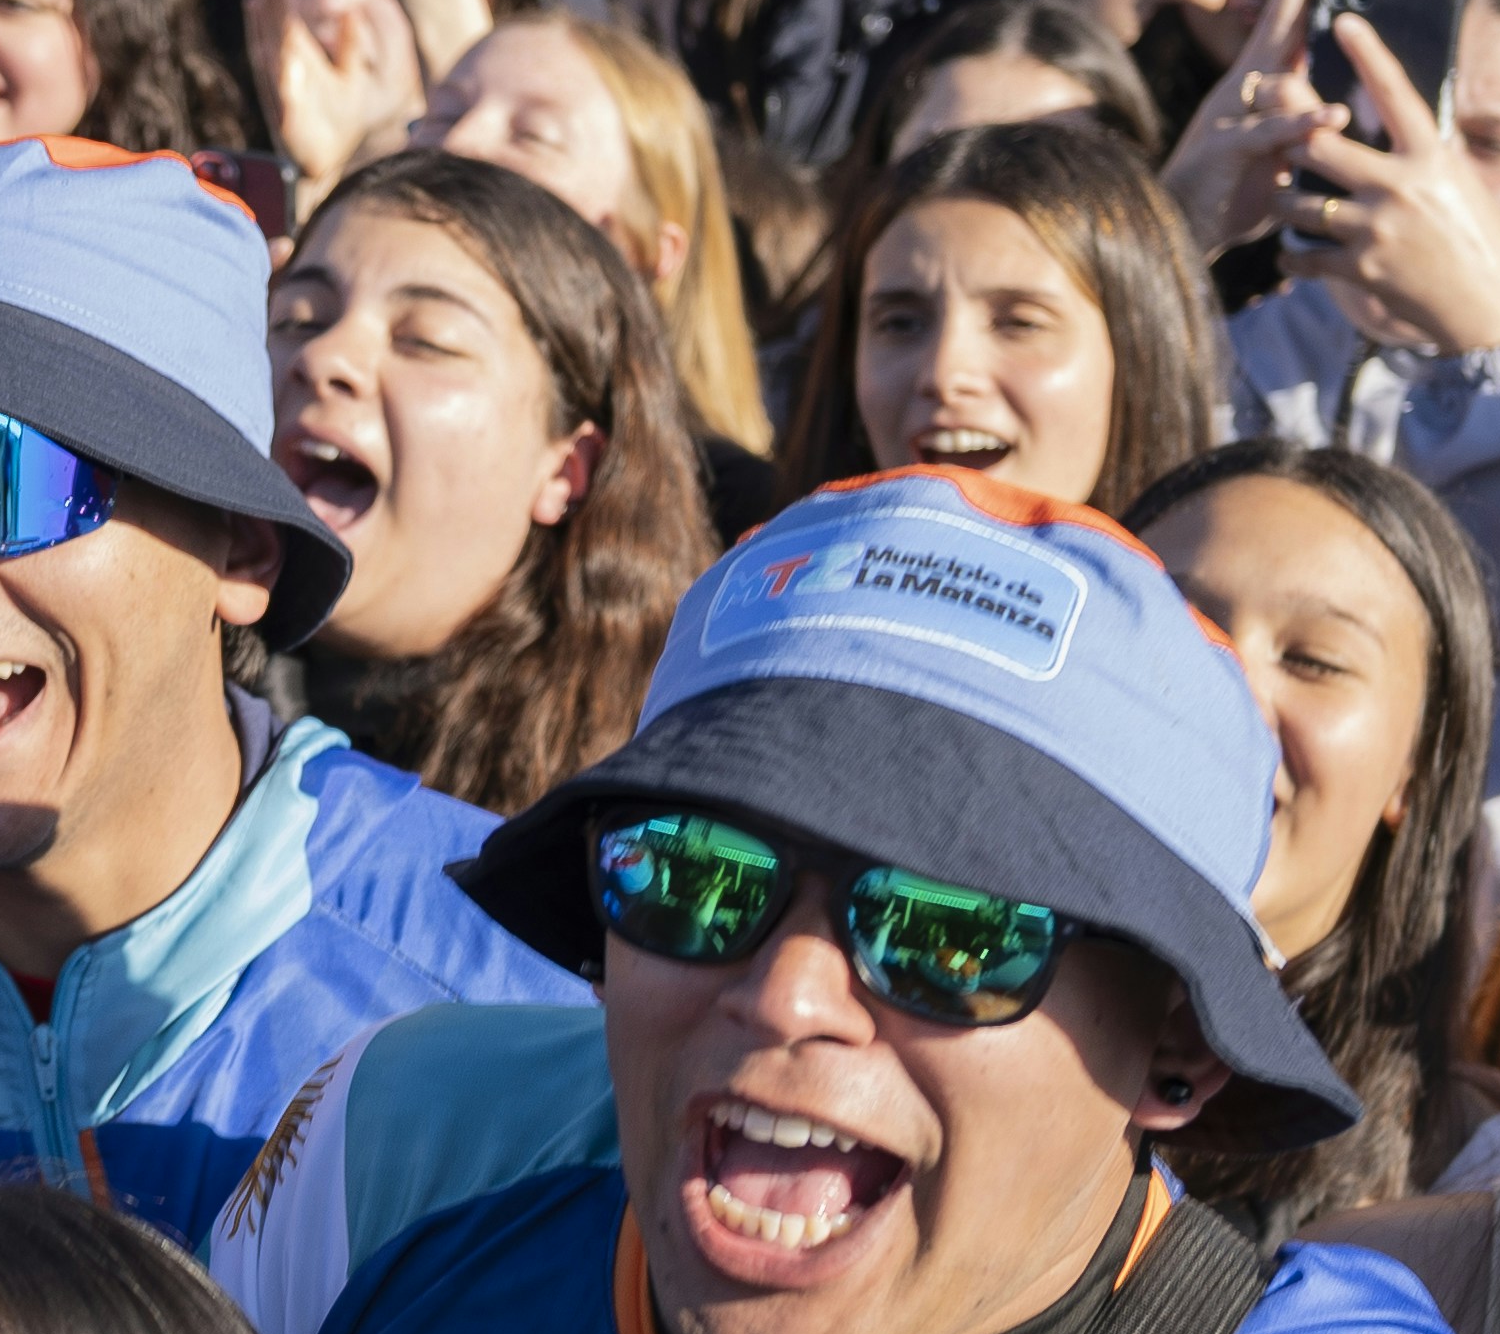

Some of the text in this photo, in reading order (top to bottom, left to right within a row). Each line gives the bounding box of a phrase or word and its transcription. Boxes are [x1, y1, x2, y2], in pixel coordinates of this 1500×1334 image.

[713, 541, 867, 621] MTZ
[853, 567, 1055, 641] La Matanza
[864, 543, 1044, 608] Municipio de
